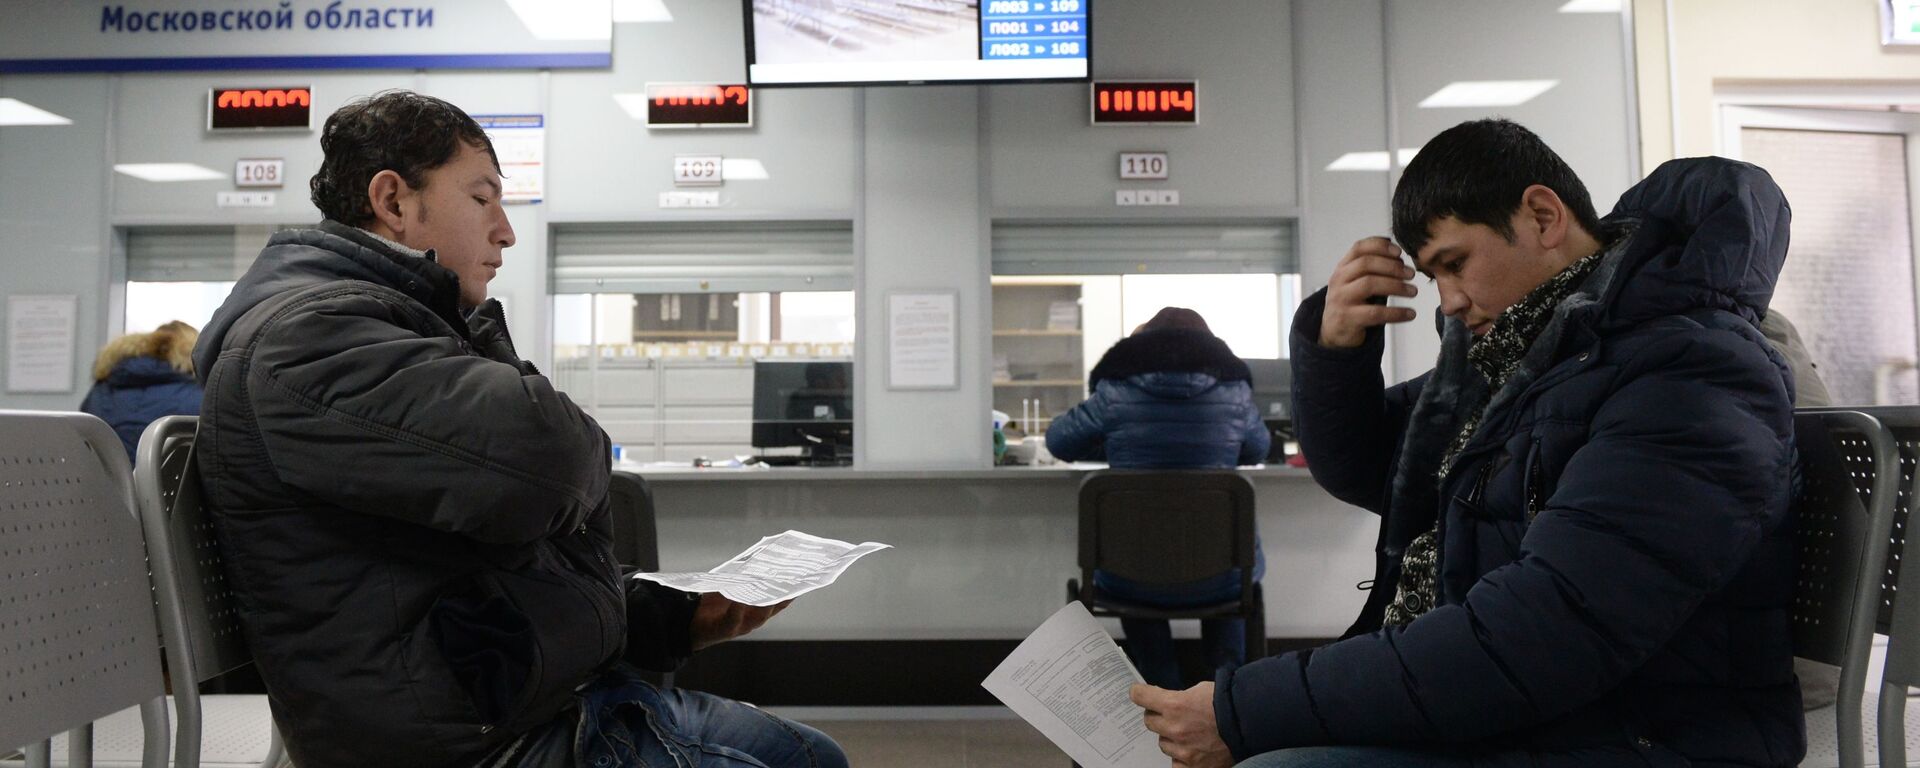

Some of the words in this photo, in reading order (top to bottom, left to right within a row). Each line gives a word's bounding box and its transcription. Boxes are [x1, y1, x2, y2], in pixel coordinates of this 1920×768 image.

[1050, 0, 1079, 12] 109
[101, 2, 293, 32] Московской
[305, 1, 434, 29] области
[989, 21, 1028, 34] П001
[1051, 20, 1079, 33] 104
[989, 43, 1030, 56] Л002
[1051, 42, 1079, 55] 108
[243, 164, 277, 181] 108
[681, 161, 715, 177] 109
[1127, 157, 1162, 174] 110
